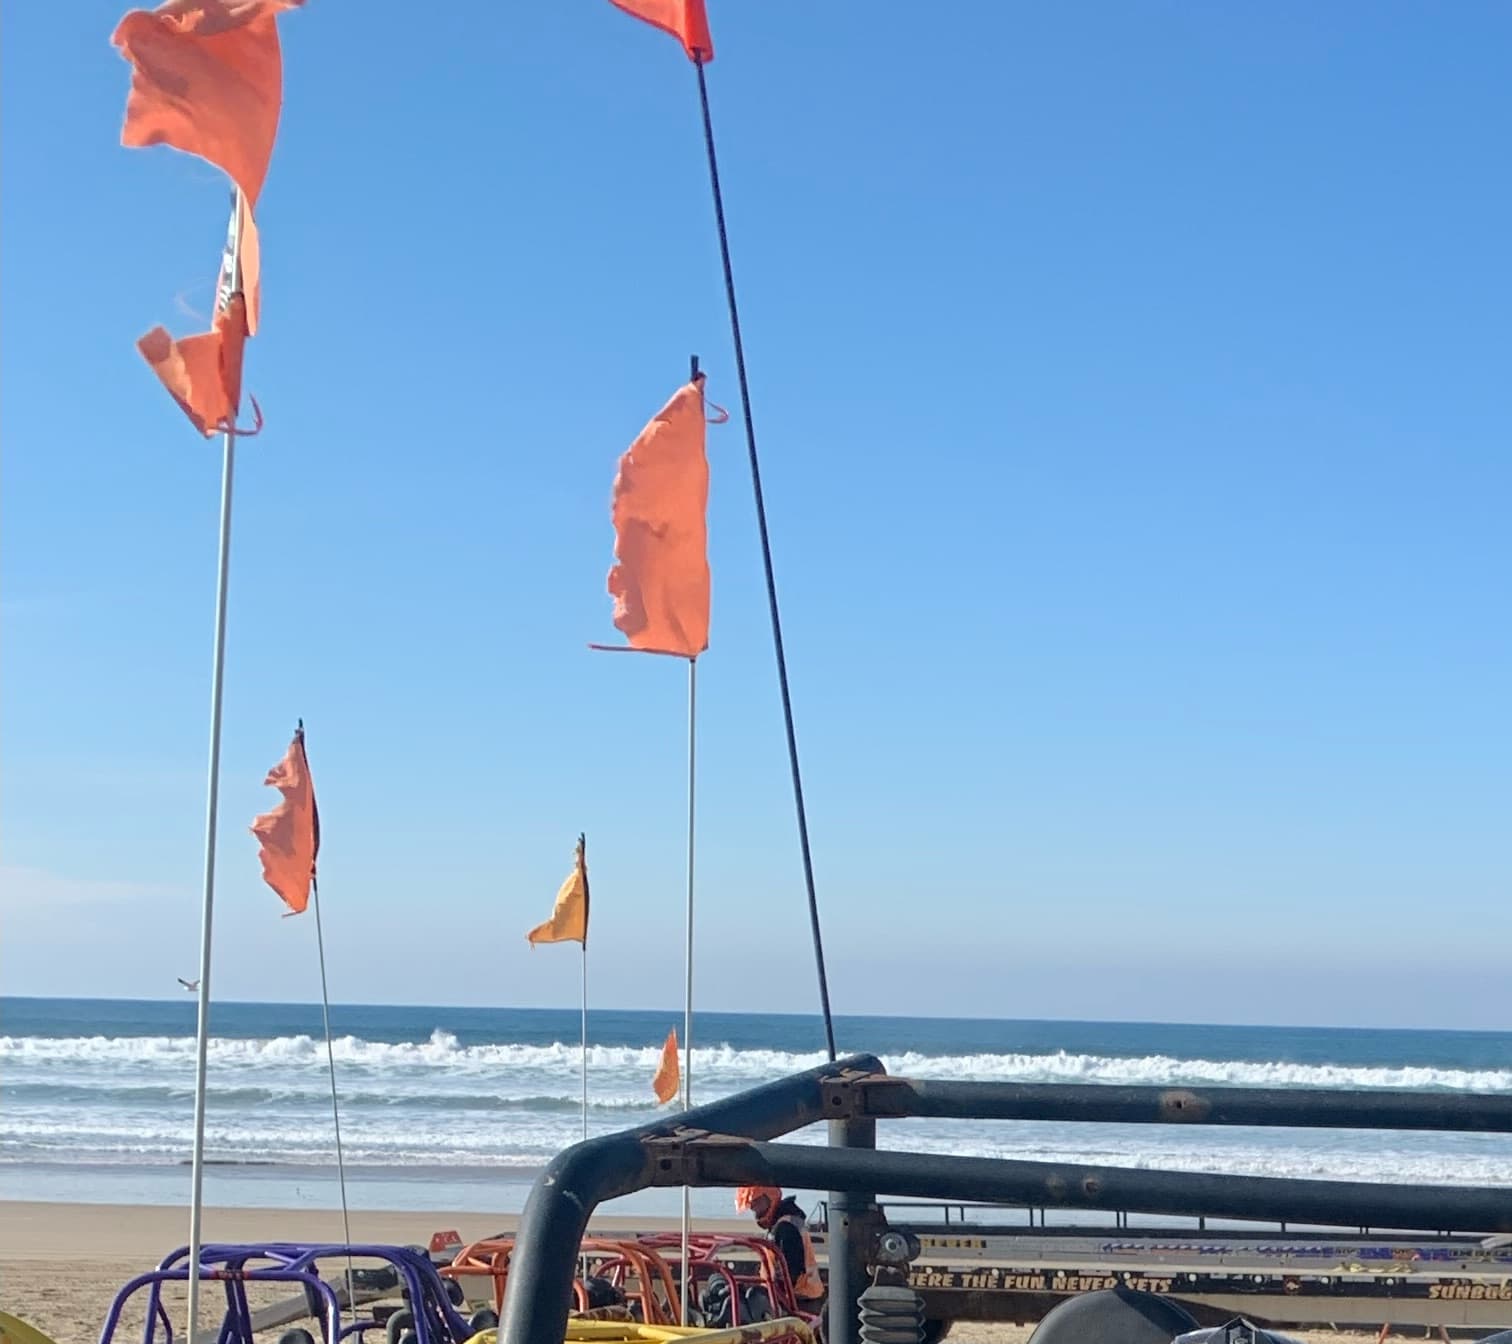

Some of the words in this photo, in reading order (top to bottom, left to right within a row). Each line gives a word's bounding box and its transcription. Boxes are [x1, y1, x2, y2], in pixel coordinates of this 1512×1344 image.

[906, 1272, 954, 1288] HERE
[961, 1274, 999, 1289] THE
[1004, 1276, 1046, 1290] FUN
